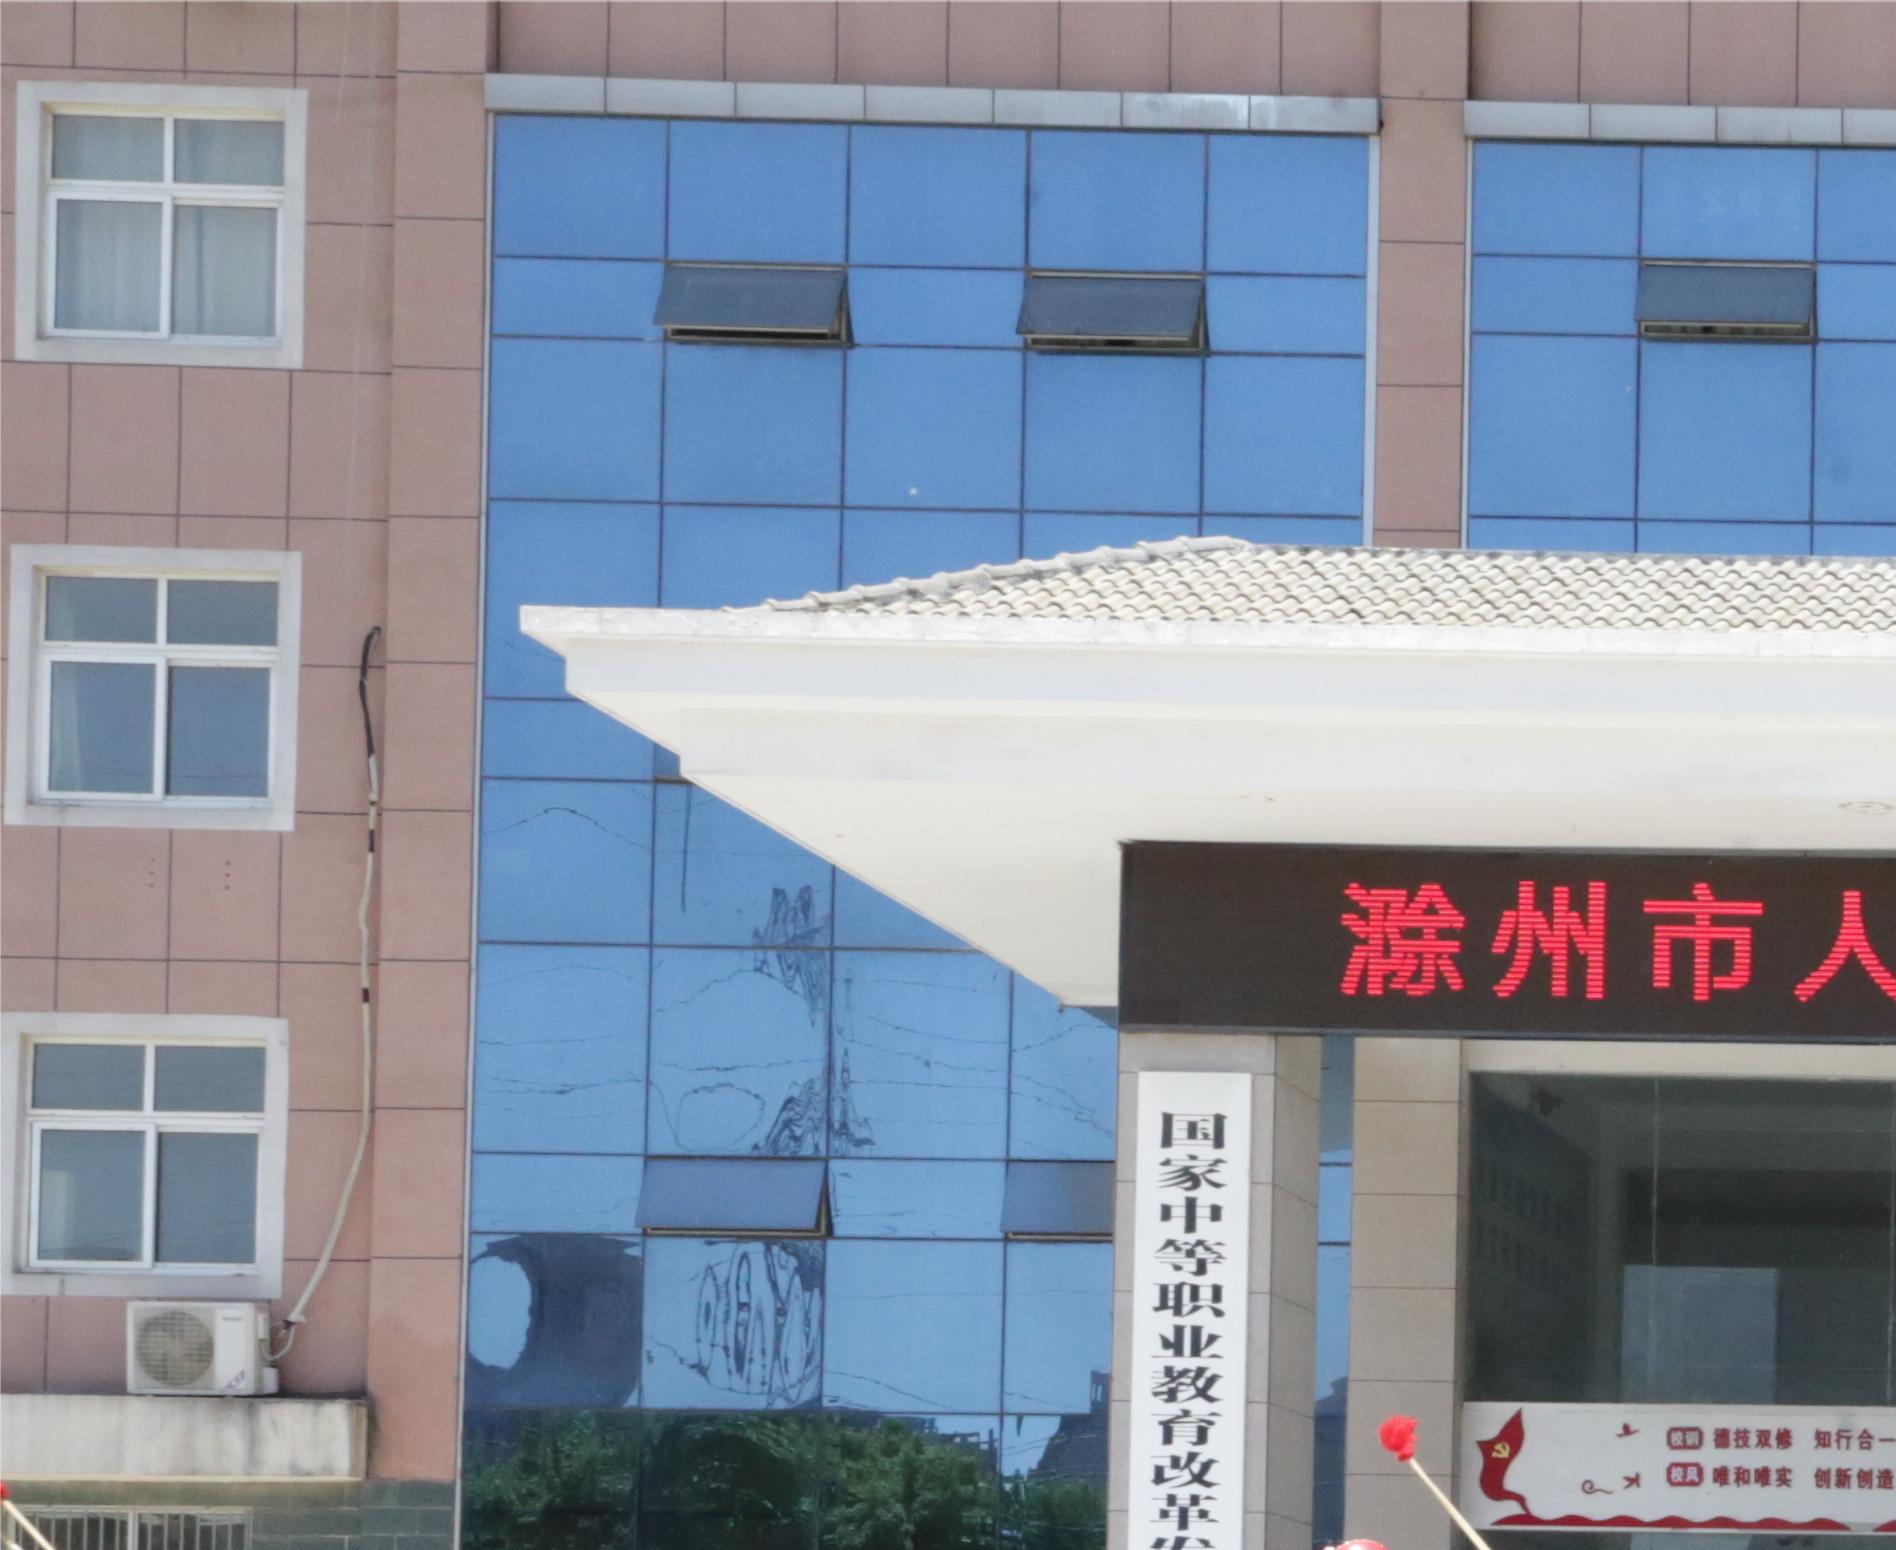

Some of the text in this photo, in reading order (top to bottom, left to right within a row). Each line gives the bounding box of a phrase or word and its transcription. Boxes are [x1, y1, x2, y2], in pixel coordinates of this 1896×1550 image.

[1713, 1428, 1793, 1450] 德技双修
[1815, 1429, 1896, 1451] 知行合一
[1713, 1467, 1793, 1488] 唯和唯实
[1815, 1468, 1895, 1490] 创新创造
